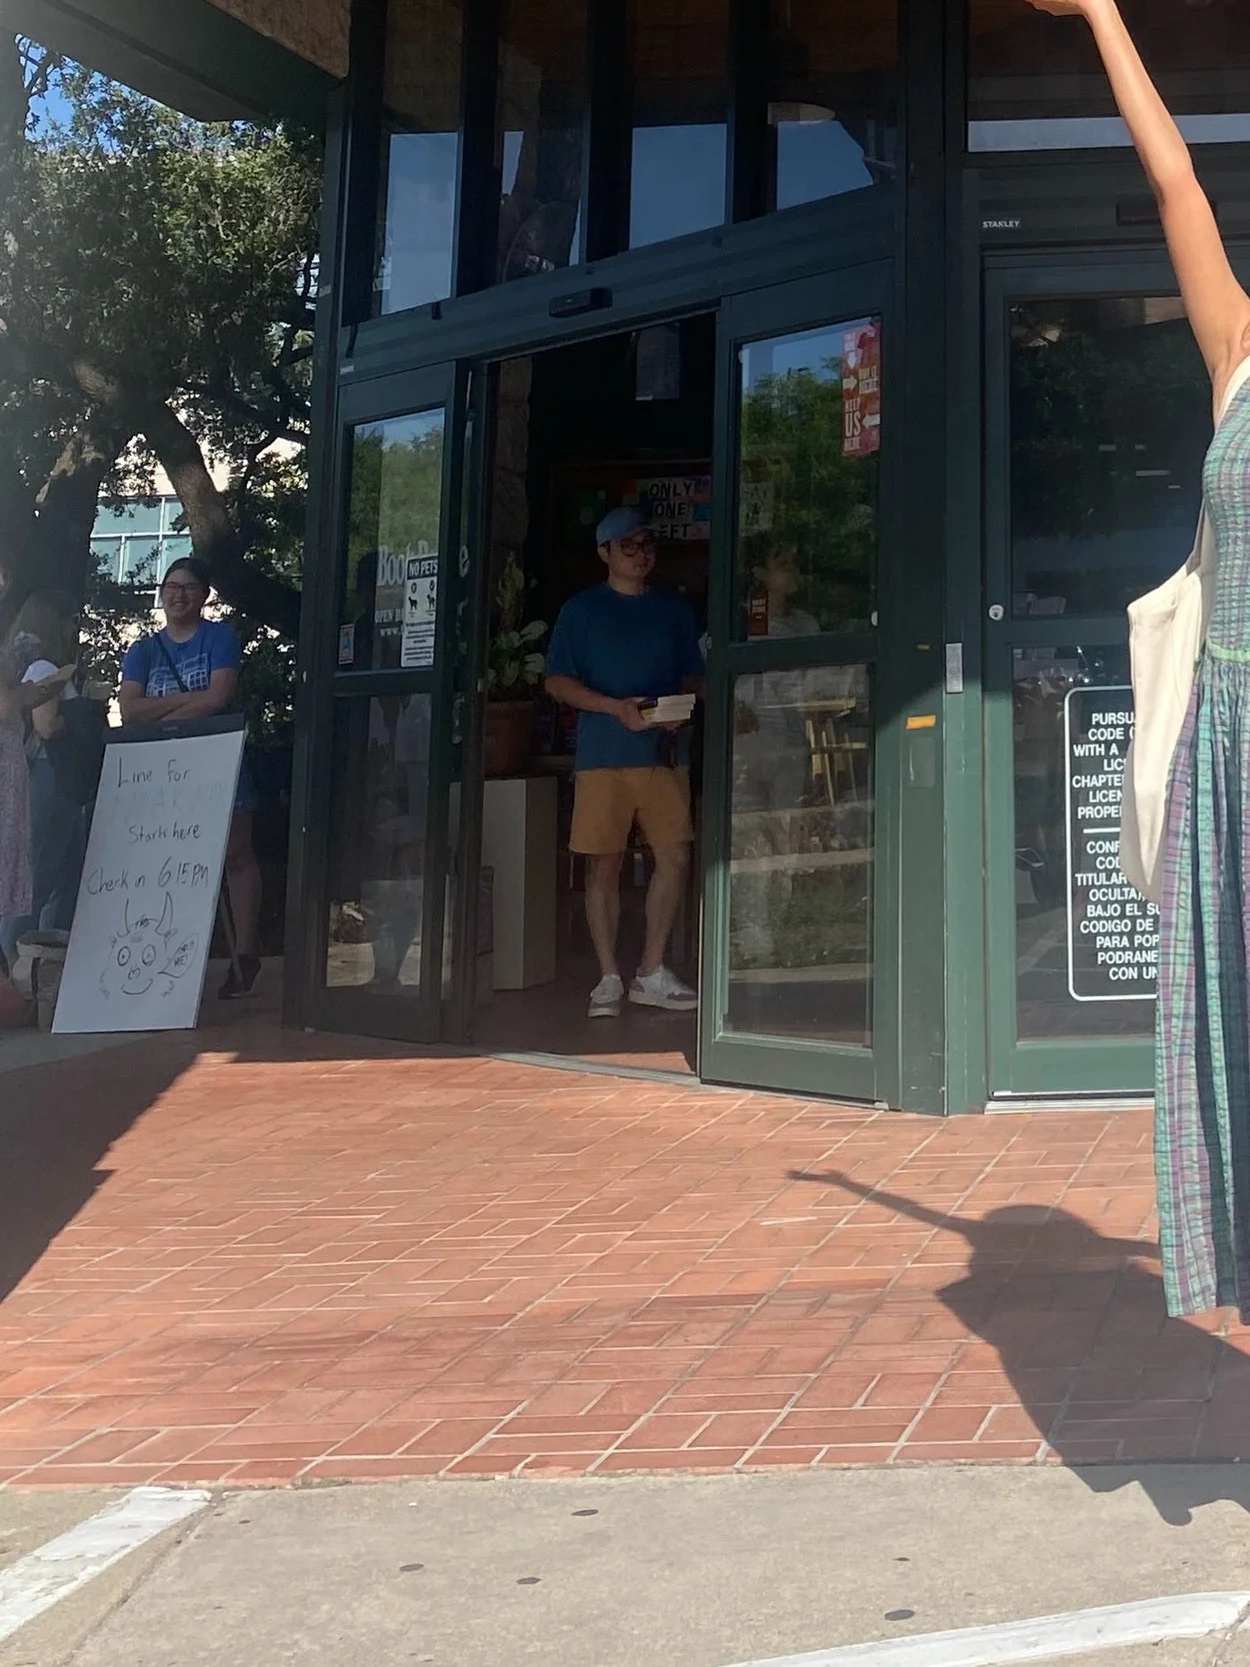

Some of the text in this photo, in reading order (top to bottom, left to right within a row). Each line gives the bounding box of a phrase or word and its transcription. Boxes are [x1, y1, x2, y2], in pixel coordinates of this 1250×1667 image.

[982, 220, 1021, 229] STANLEY
[845, 411, 862, 438] US
[649, 481, 693, 498] ONLY
[654, 502, 688, 519] ONE
[409, 562, 420, 578] NO
[420, 558, 438, 576] PETS
[1091, 712, 1135, 725] PURSU
[1088, 727, 1125, 741] CODE
[1072, 742, 1119, 757] WITH A
[119, 757, 152, 788] Line
[1072, 774, 1125, 788] CHAPTE
[1077, 806, 1123, 819] PROPE
[1075, 873, 1127, 886] TITULAR
[1086, 903, 1142, 917] BAJO EL
[1079, 919, 1154, 934] CODIGO DE
[1096, 935, 1130, 949] PARA
[1108, 966, 1138, 981] CON
